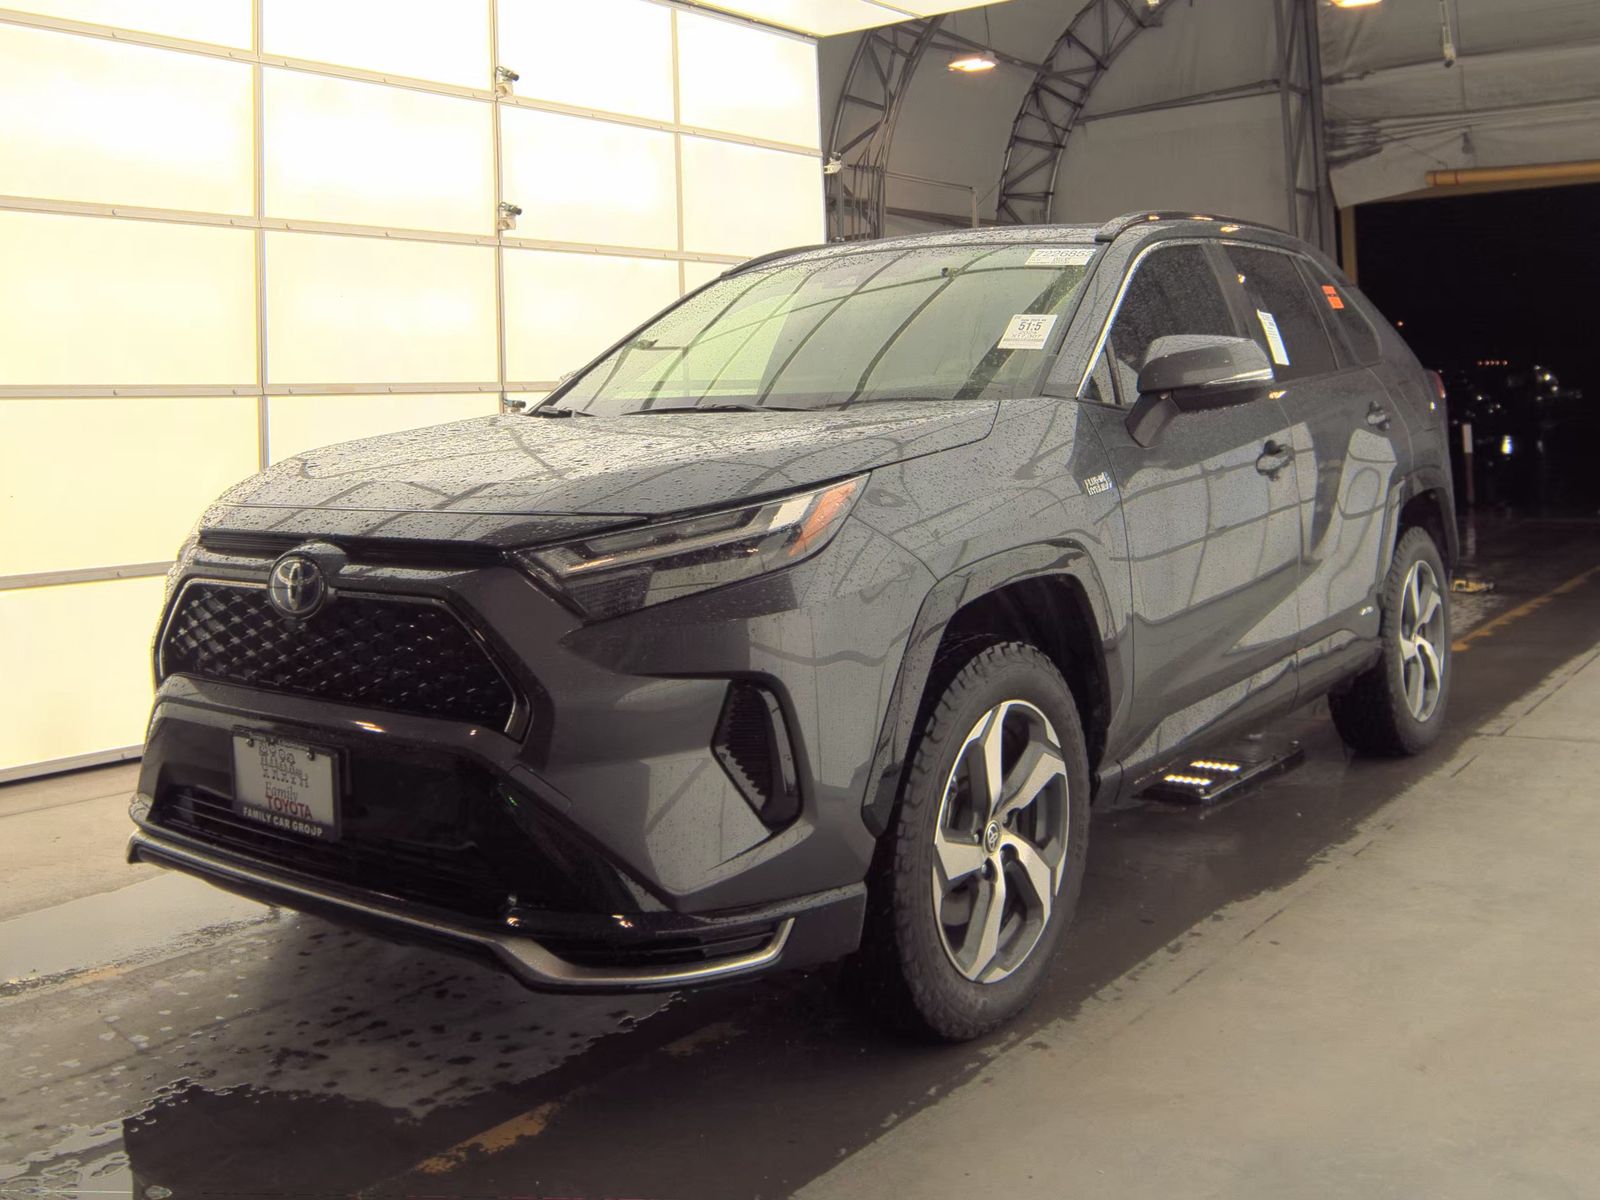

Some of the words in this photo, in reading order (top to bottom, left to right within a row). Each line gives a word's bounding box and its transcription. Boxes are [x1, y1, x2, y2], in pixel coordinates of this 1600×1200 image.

[265, 781, 298, 802] Family
[265, 795, 313, 819] TOYOTA
[243, 806, 271, 823] FAMILY
[273, 816, 290, 829] CAR
[292, 821, 323, 837] GROUP
